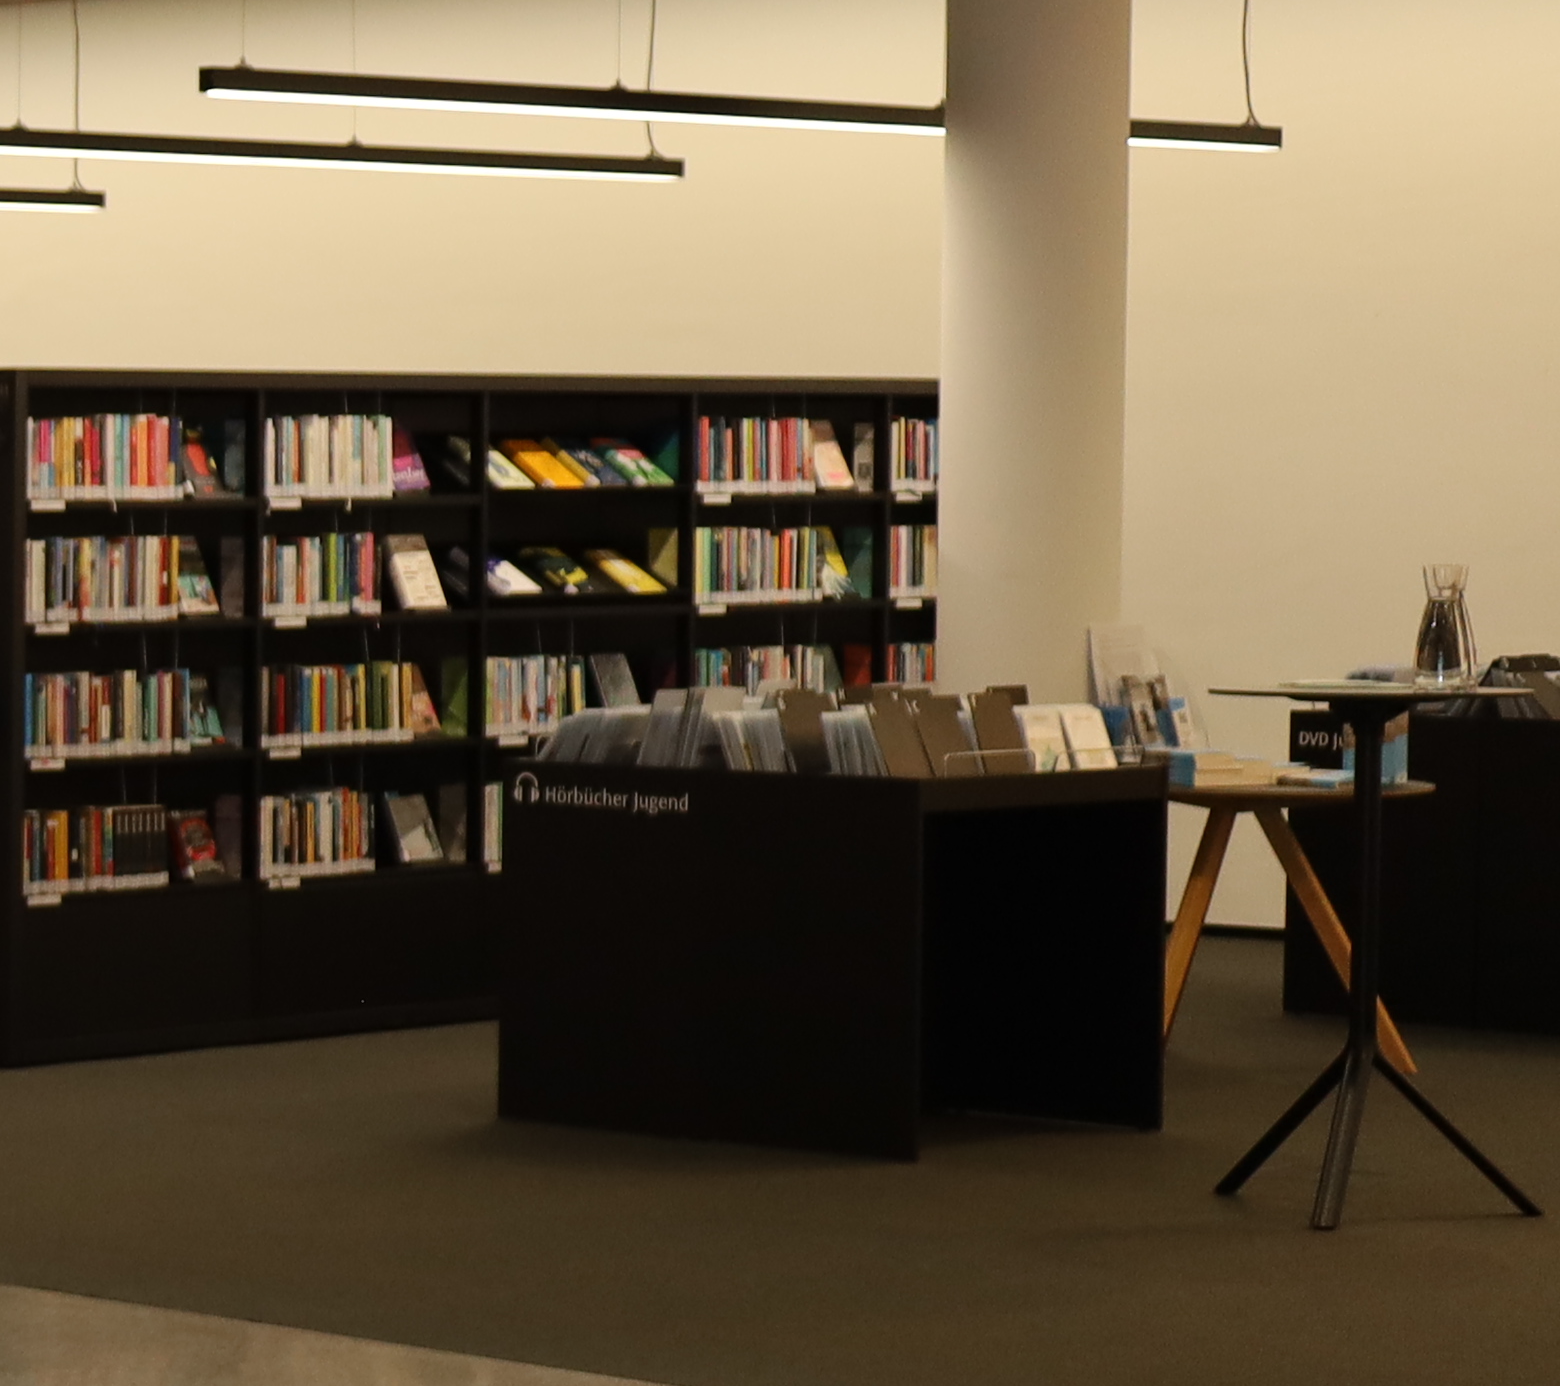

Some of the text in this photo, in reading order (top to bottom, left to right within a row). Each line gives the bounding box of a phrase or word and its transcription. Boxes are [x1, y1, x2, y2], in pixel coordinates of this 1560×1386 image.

[1299, 731, 1329, 746] DVD
[545, 783, 690, 814] Hörbücher Jugend
